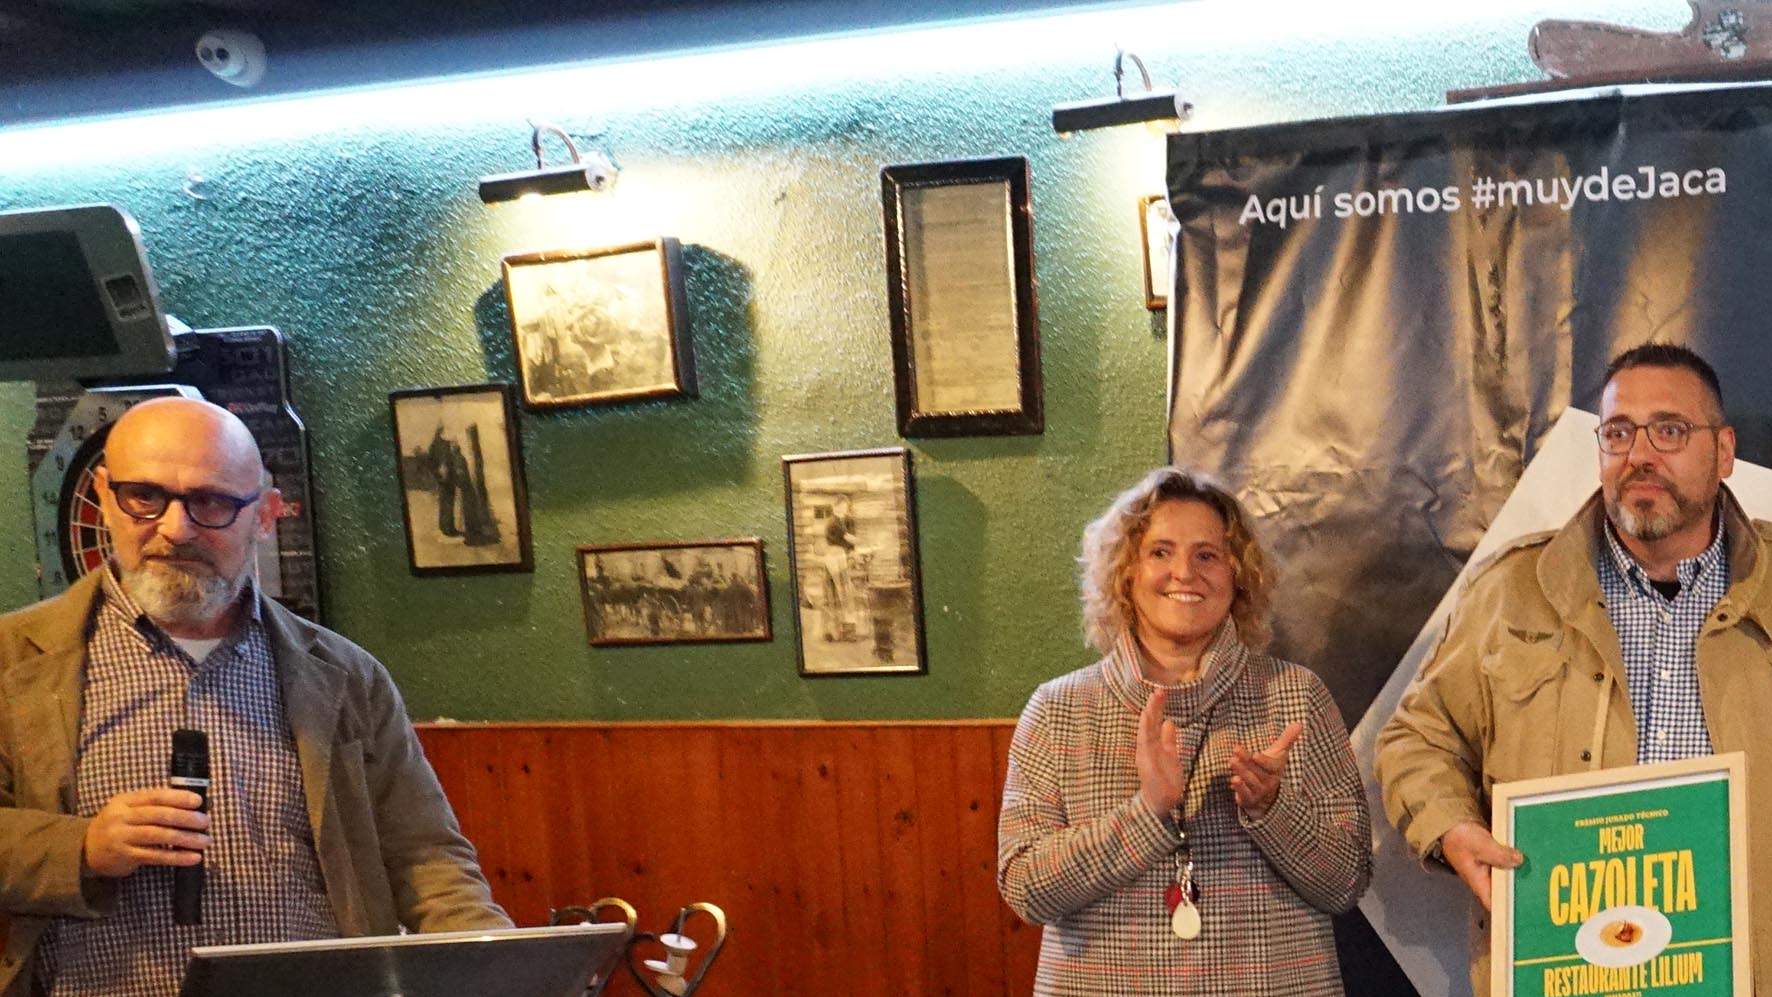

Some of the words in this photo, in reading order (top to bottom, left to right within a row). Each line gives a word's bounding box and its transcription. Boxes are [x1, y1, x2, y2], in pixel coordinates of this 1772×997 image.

[1239, 187, 1322, 229] Aquí
[1334, 182, 1461, 219] somos
[1471, 166, 1728, 211] #muydeJaca
[1599, 823, 1645, 854] MEJOR
[1548, 849, 1697, 926] CAZOLETA
[1650, 952, 1704, 988] LILIUM
